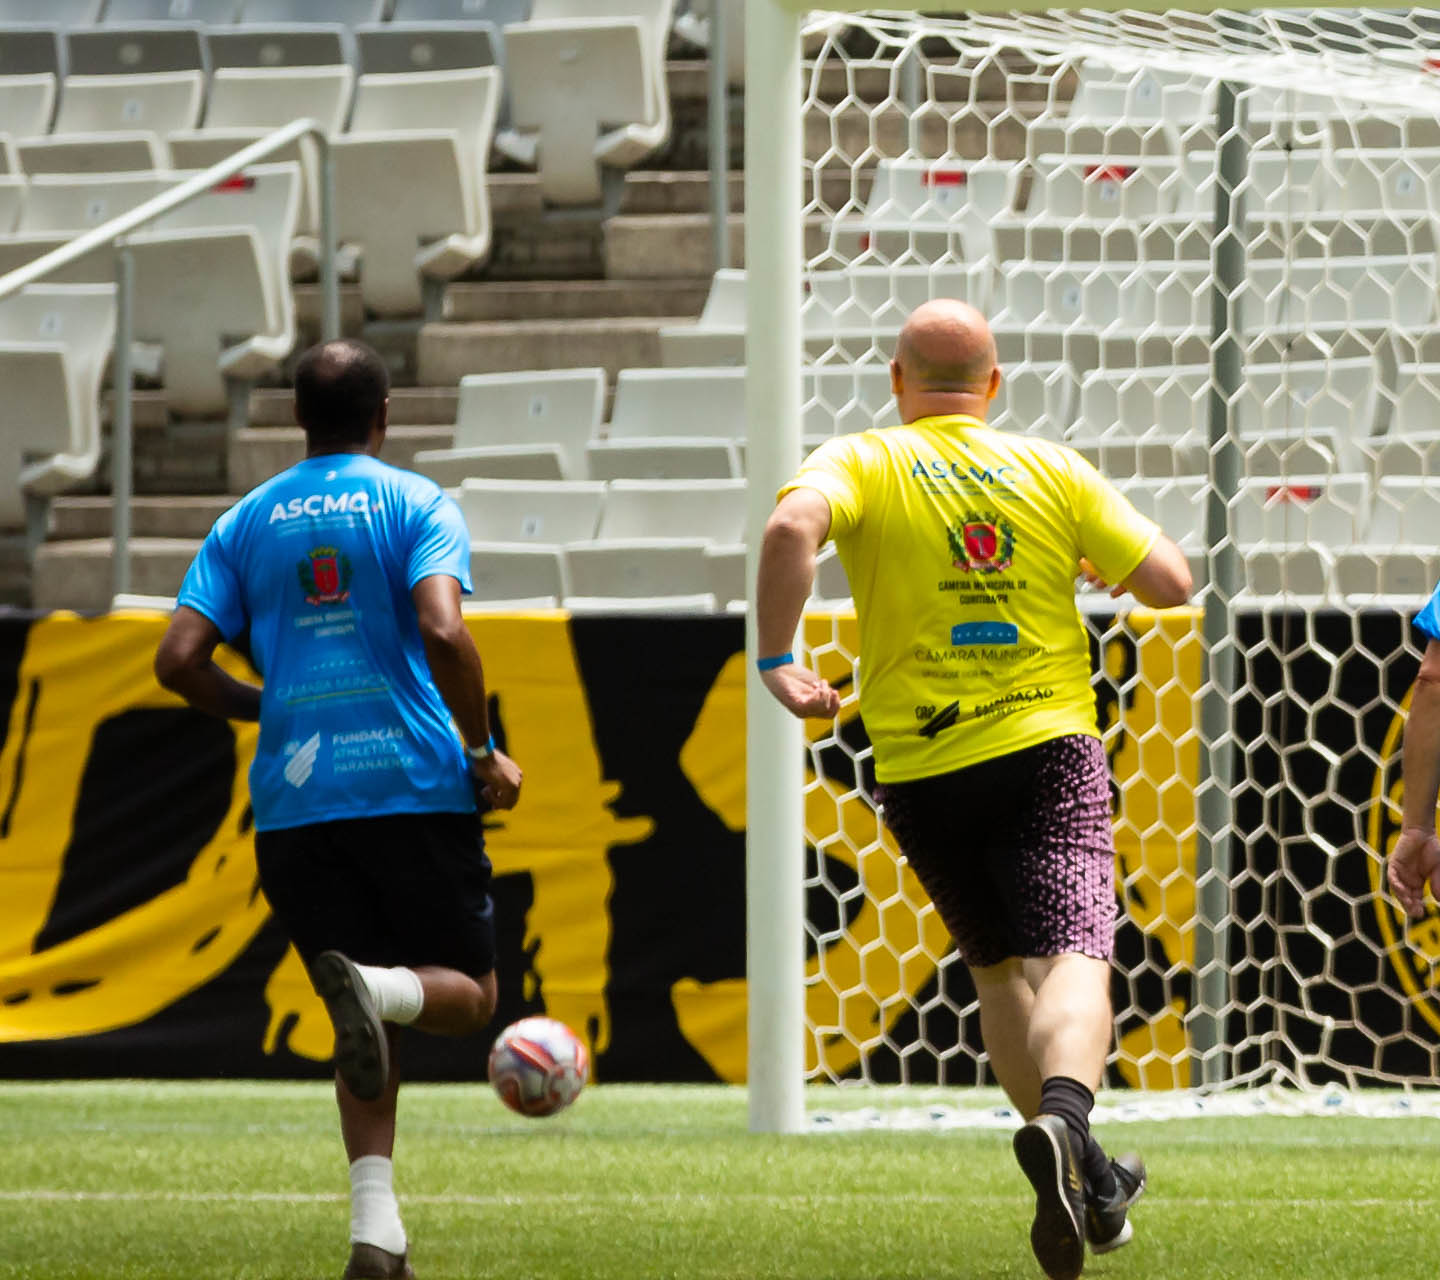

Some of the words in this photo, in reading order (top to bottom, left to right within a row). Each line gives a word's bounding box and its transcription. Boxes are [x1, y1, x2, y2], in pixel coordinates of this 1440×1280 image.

[268, 491, 369, 525] ASCMC
[914, 647, 978, 663] CÂMARA
[333, 726, 404, 746] FUNDAÇÃO
[333, 742, 399, 759] ATHLETICO
[333, 757, 416, 774] PARANAENSE
